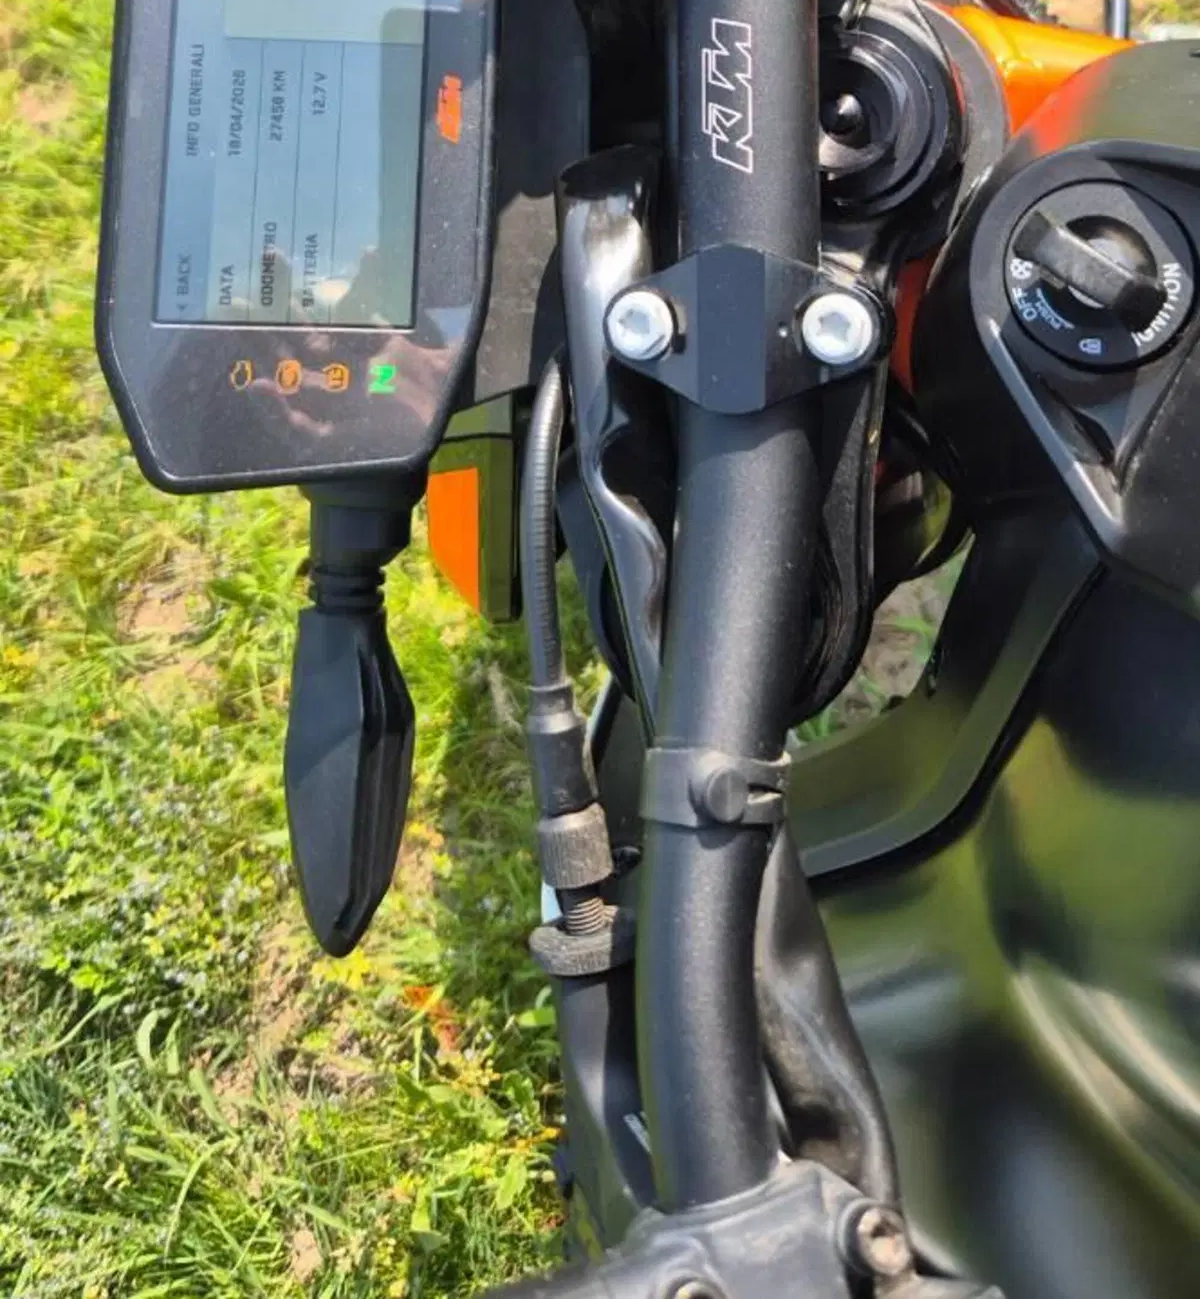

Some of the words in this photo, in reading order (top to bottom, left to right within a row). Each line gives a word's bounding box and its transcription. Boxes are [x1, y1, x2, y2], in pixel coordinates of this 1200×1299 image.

[187, 43, 205, 117] GENERALI
[271, 70, 287, 93] KM
[313, 71, 328, 83] V
[701, 17, 753, 174] KTM
[311, 85, 327, 116] 12.7
[186, 122, 199, 157] INFO
[177, 253, 192, 297] BACK
[219, 264, 234, 306] DATA
[260, 221, 278, 308] ODOMETRO
[302, 233, 318, 308] BATTERIA
[1011, 287, 1037, 322] OFF
[1130, 262, 1182, 347] IGNITION
